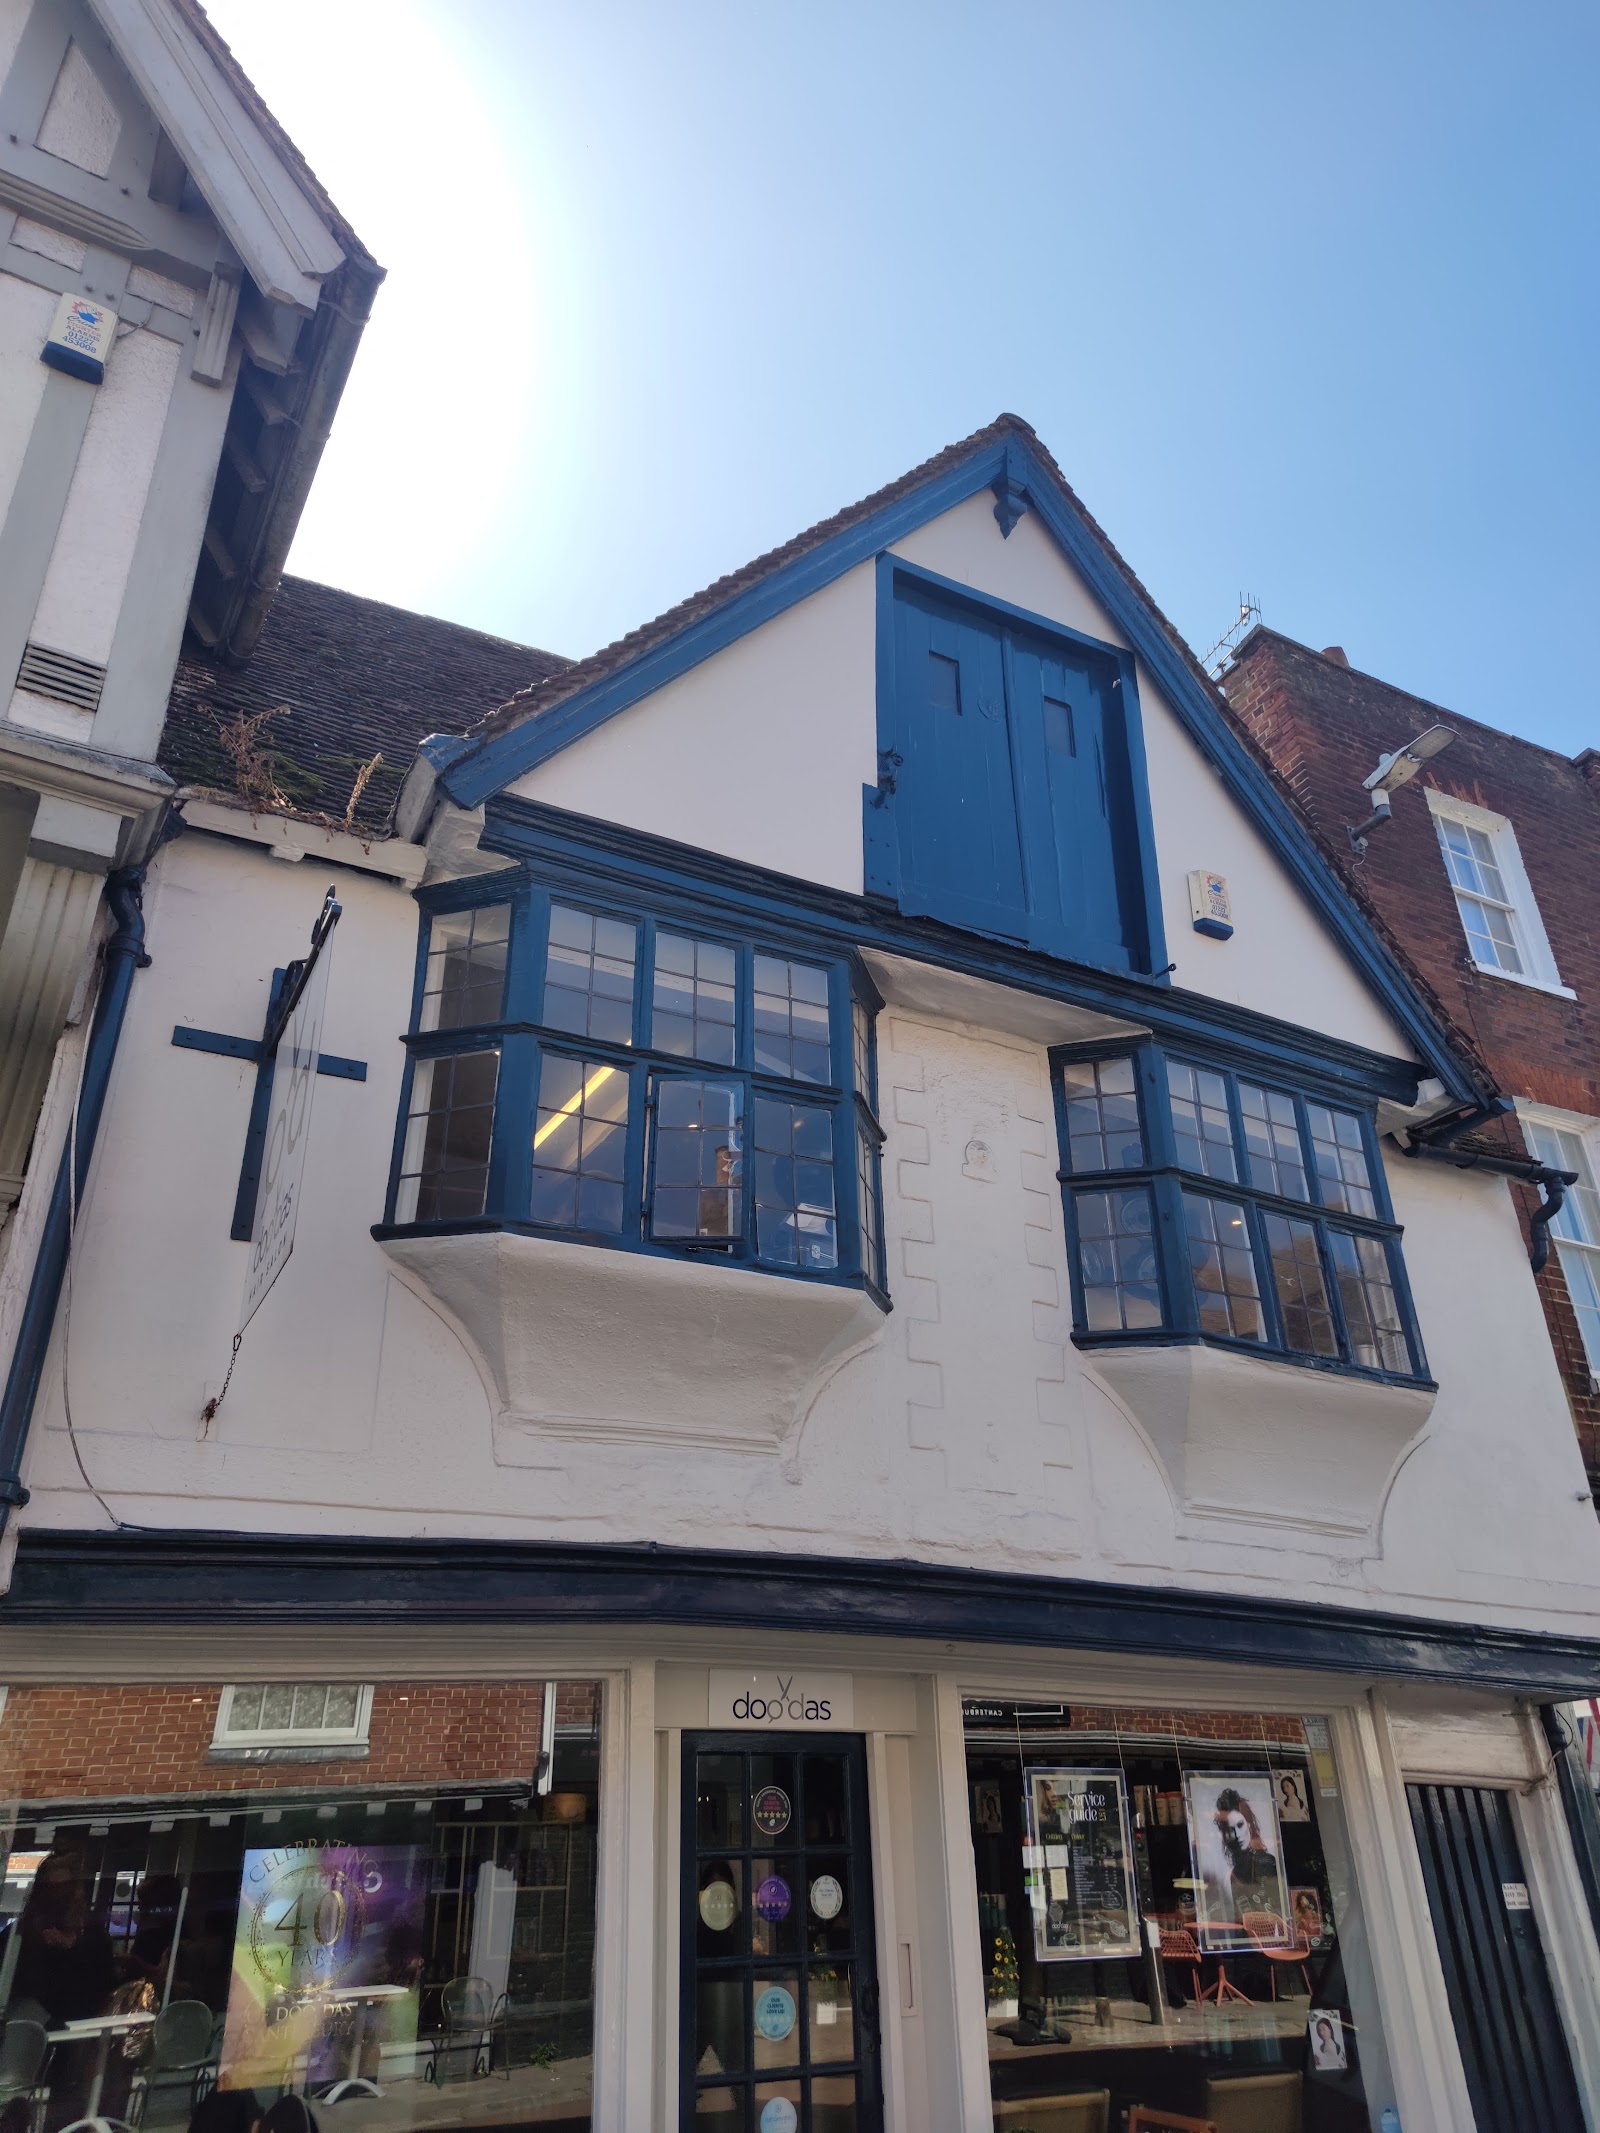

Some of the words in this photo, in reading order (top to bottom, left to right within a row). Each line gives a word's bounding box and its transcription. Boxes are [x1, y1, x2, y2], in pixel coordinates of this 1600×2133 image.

[65, 324, 100, 342] ALARMS
[68, 331, 95, 345] 01227
[62, 335, 97, 353] 453008
[248, 1272, 264, 1304] HAIR
[265, 1230, 288, 1276] SALON
[1067, 1788, 1106, 1807] Service
[1068, 1806, 1098, 1825] guide
[249, 1837, 379, 1884] CELEBRATING
[274, 1890, 346, 1947] 40
[278, 1947, 338, 1967] YEARS
